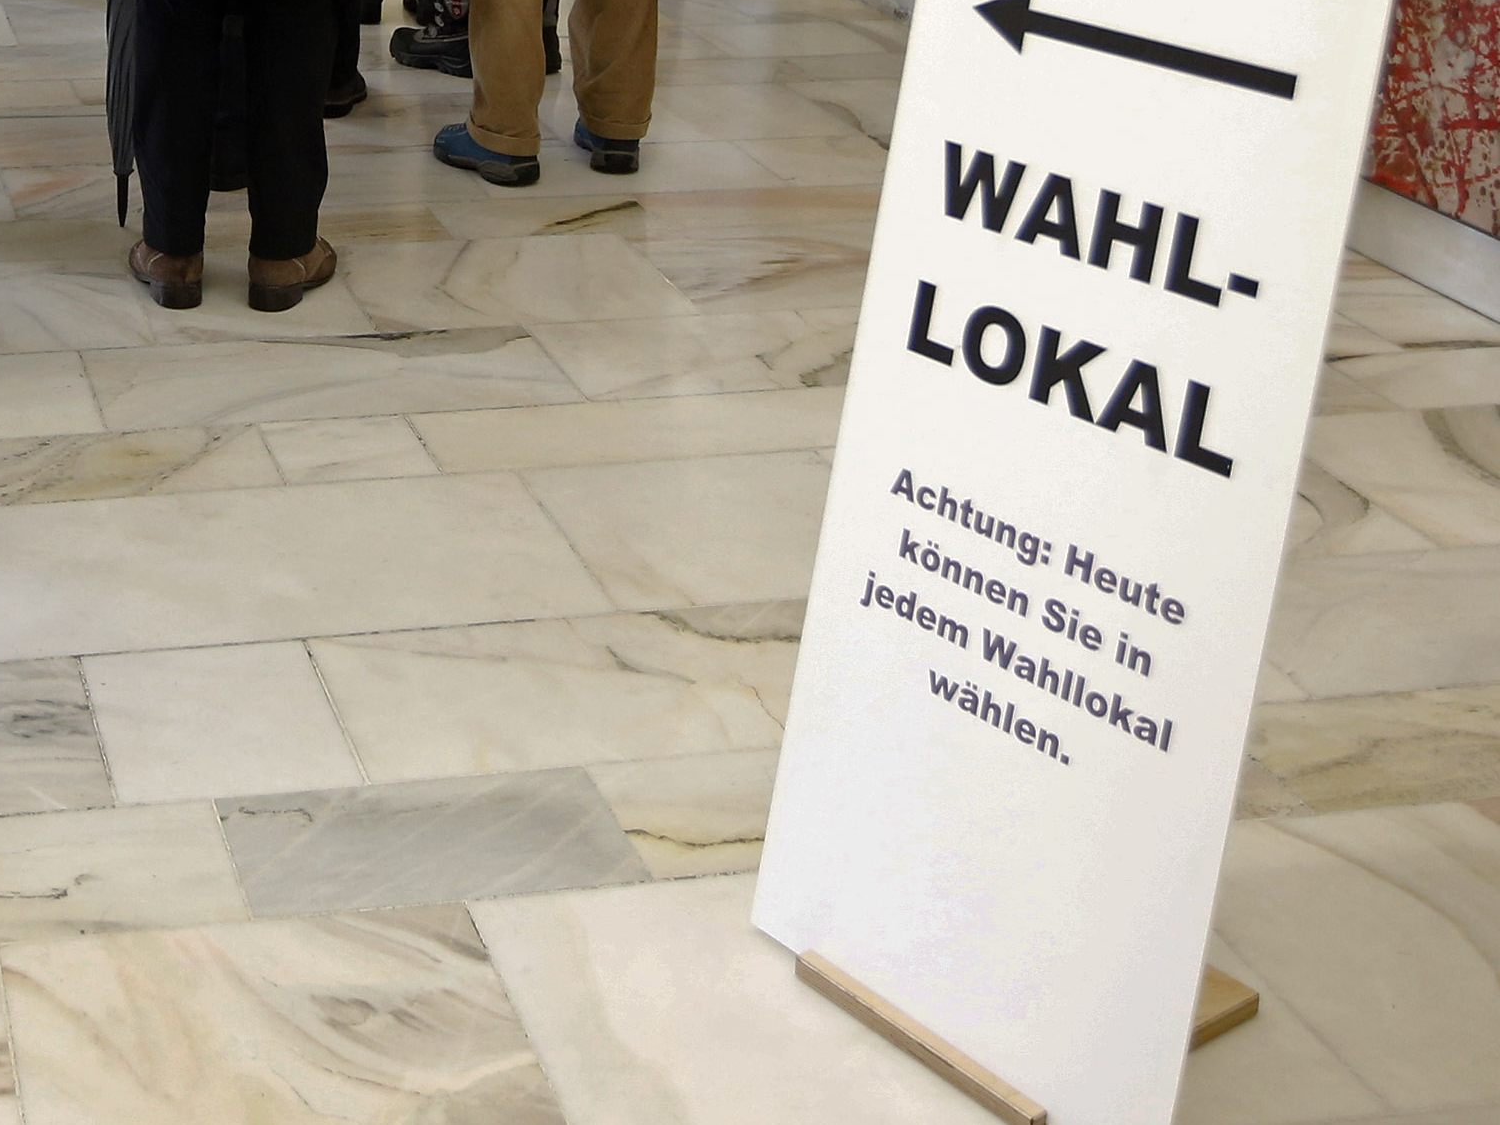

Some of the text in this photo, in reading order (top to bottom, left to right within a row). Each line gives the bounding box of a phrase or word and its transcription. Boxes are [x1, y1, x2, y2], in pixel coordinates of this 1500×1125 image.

[944, 139, 1260, 309] WAHL-
[906, 278, 1234, 479] LOKAL
[889, 467, 1186, 626] Achtung: Heute
[898, 528, 1152, 677] können Sie in
[859, 570, 1174, 753] jedem Wahllokal
[928, 669, 1071, 766] wählen.
